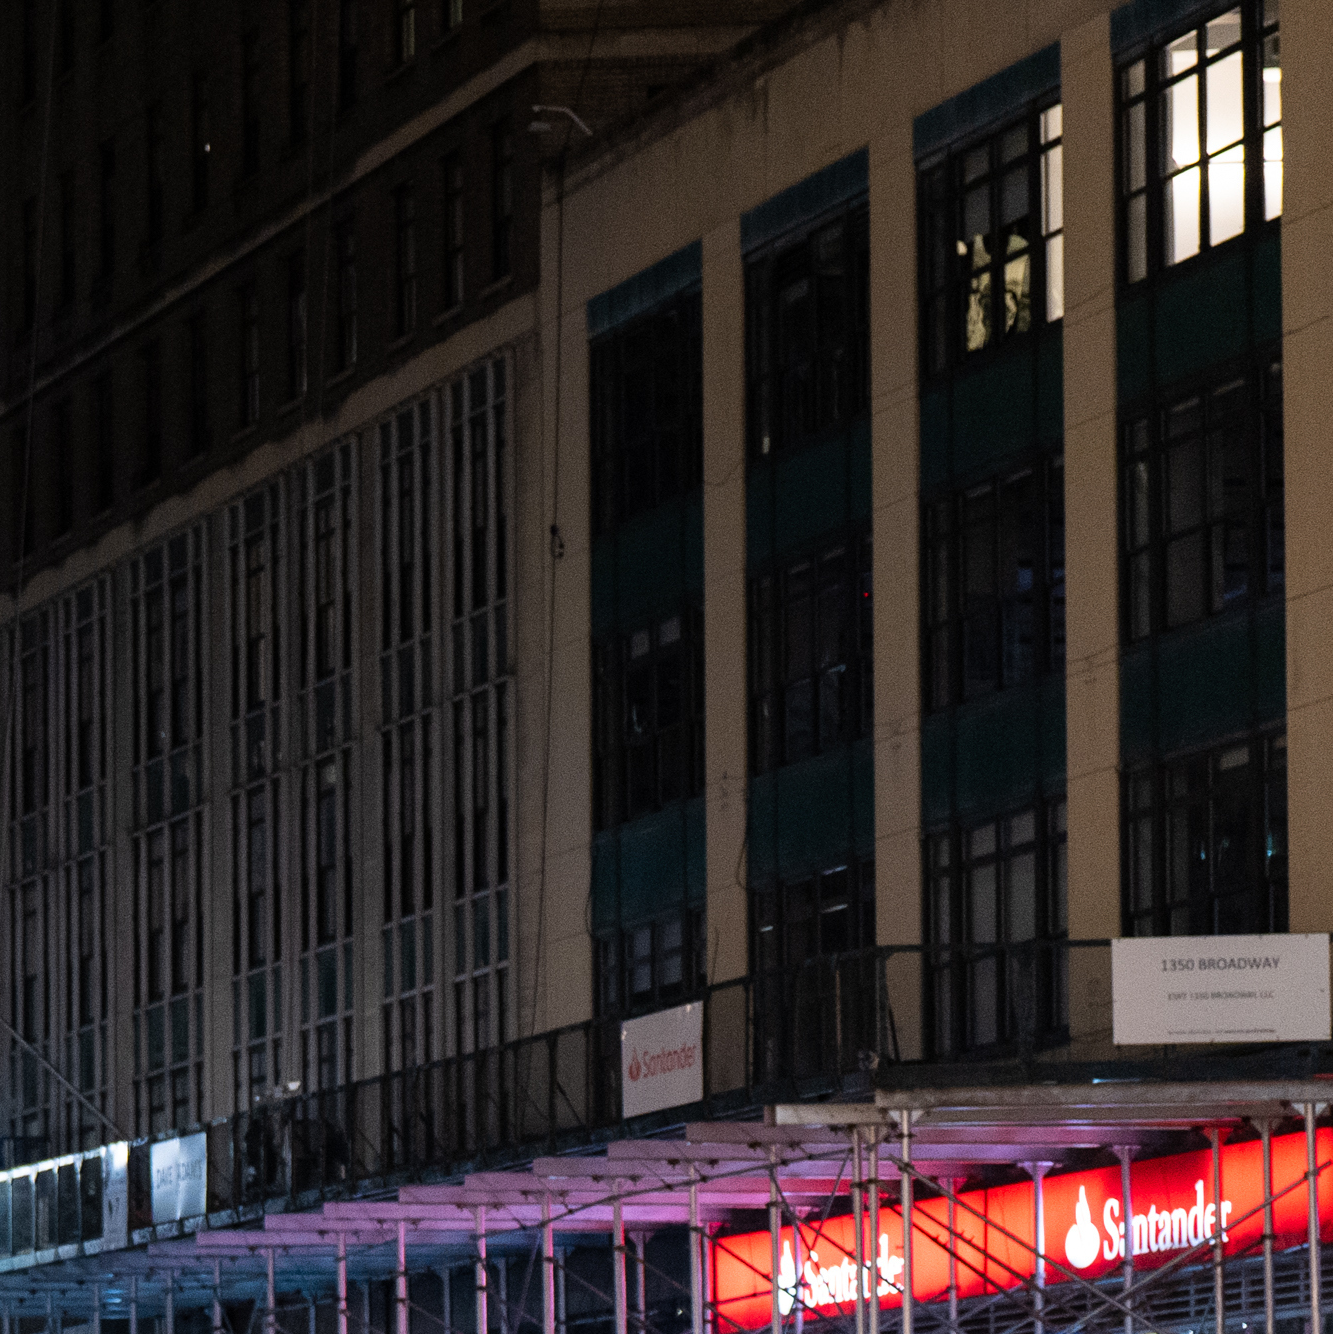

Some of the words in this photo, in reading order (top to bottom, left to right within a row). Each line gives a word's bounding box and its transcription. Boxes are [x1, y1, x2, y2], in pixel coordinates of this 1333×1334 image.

[1161, 958, 1195, 972] 1350
[1198, 956, 1280, 971] BROADWAY
[643, 1043, 696, 1078] Santander
